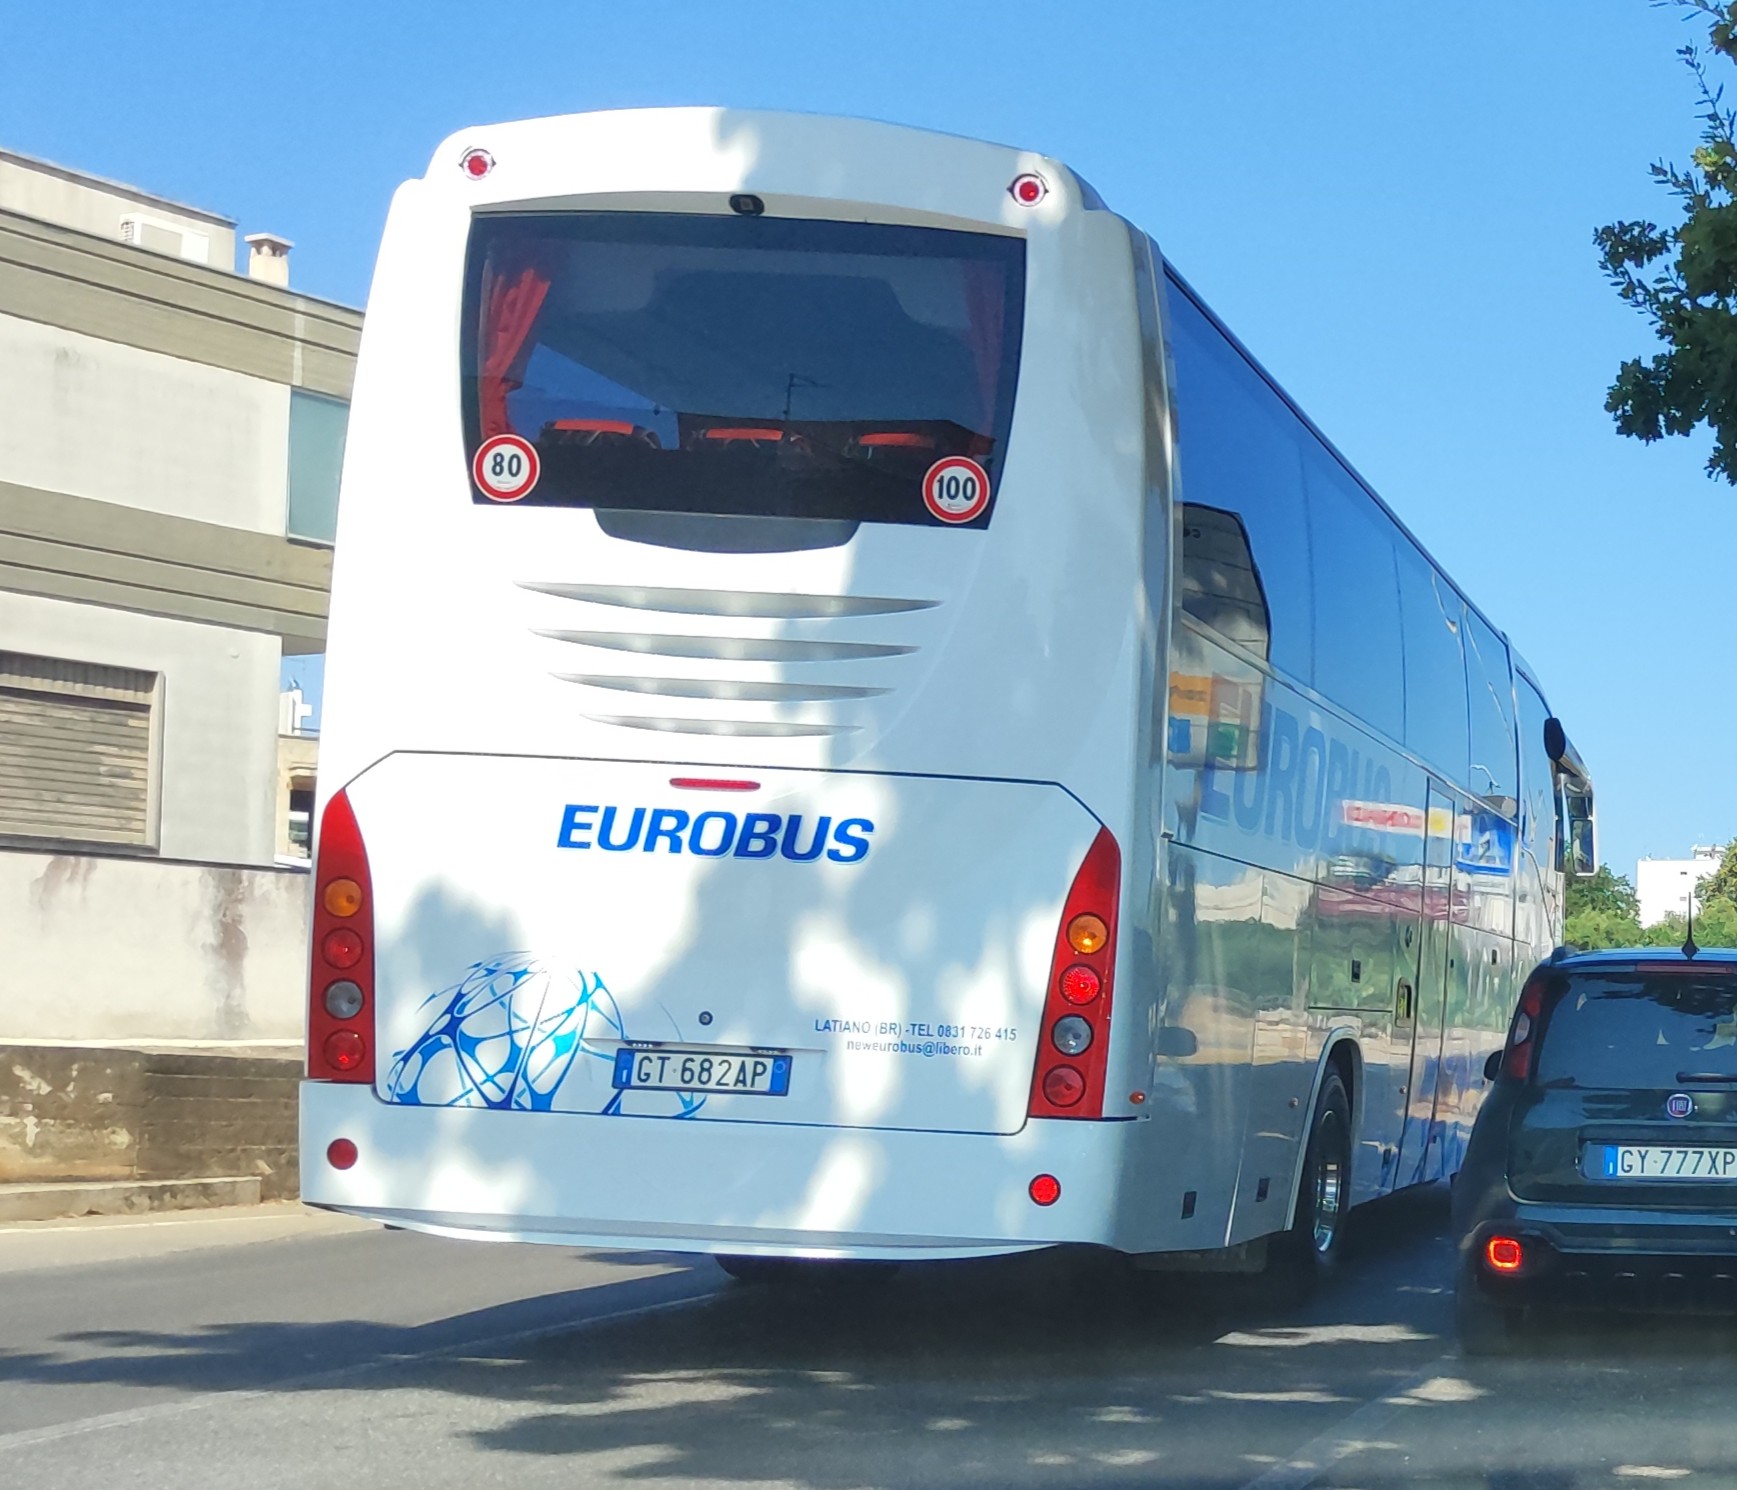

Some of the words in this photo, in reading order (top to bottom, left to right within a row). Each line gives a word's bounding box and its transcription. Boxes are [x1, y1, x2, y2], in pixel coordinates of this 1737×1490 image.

[491, 452, 521, 477] 80
[936, 475, 976, 501] 100
[557, 804, 874, 864] EUROBUS
[814, 1019, 871, 1034] LATIANO
[874, 1021, 902, 1037] (BR)
[937, 1025, 966, 1038] 0831
[970, 1027, 991, 1039] 726
[995, 1027, 1017, 1041] 415
[846, 1040, 982, 1057] neweurobus@libero.it
[637, 1056, 671, 1083] GT
[680, 1057, 767, 1088] 682AP
[1620, 1149, 1649, 1174] GY
[1660, 1150, 1736, 1175] 777XP
